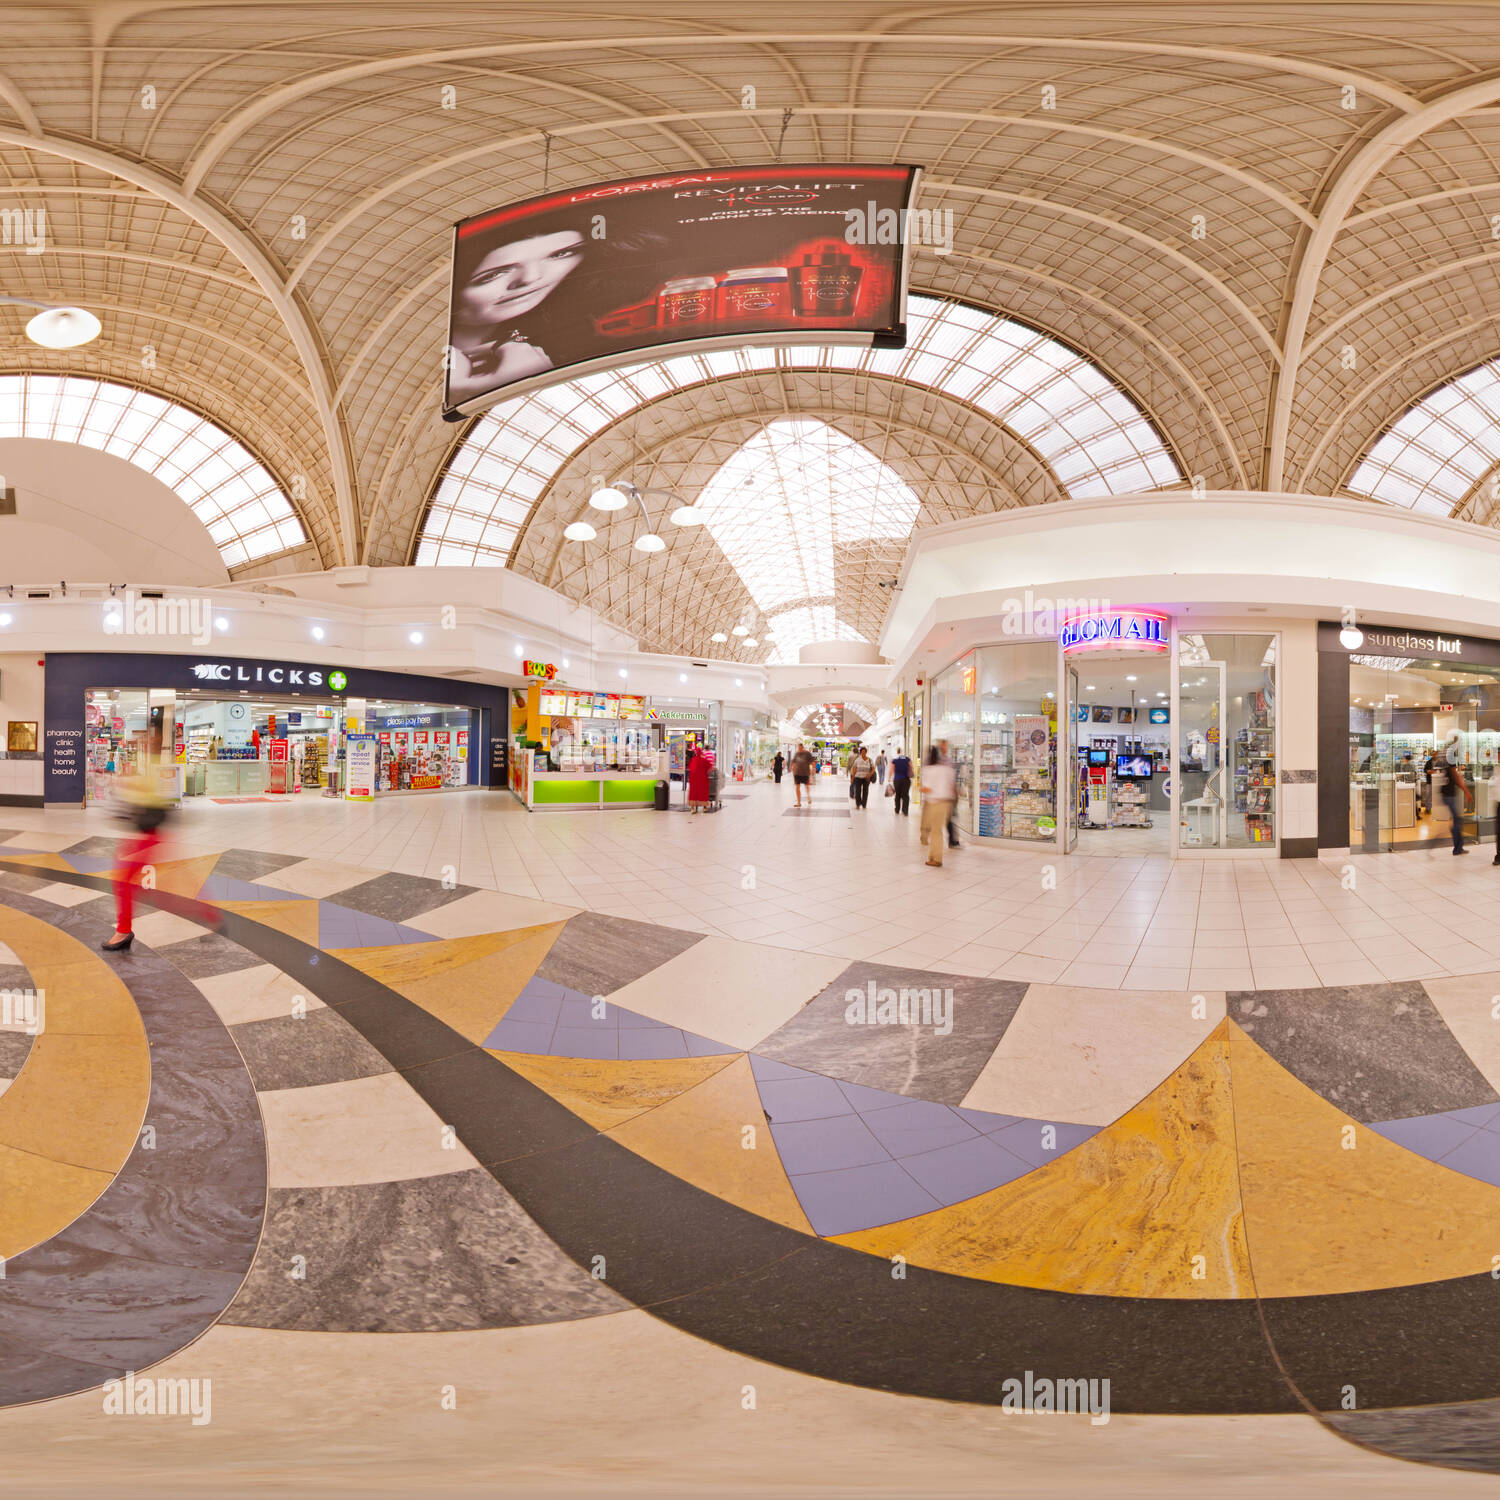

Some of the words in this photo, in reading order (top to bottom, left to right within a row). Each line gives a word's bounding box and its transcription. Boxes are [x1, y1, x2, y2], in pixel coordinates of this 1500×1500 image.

[673, 183, 865, 199] REVITALIFT
[698, 213, 750, 222] SIGNS
[711, 208, 773, 217] FIGHTS
[1060, 616, 1169, 647] GLOMAIL
[1367, 632, 1434, 652] sunglass
[1436, 636, 1462, 655] hut
[524, 659, 558, 680] BOOST
[215, 664, 323, 686] CLICKS
[659, 710, 707, 720] Ackermans
[387, 718, 405, 727] please
[416, 715, 431, 725] here
[47, 729, 82, 737] pharmacy
[56, 738, 73, 746] clinic
[53, 748, 76, 756] health
[51, 768, 77, 776] beauty
